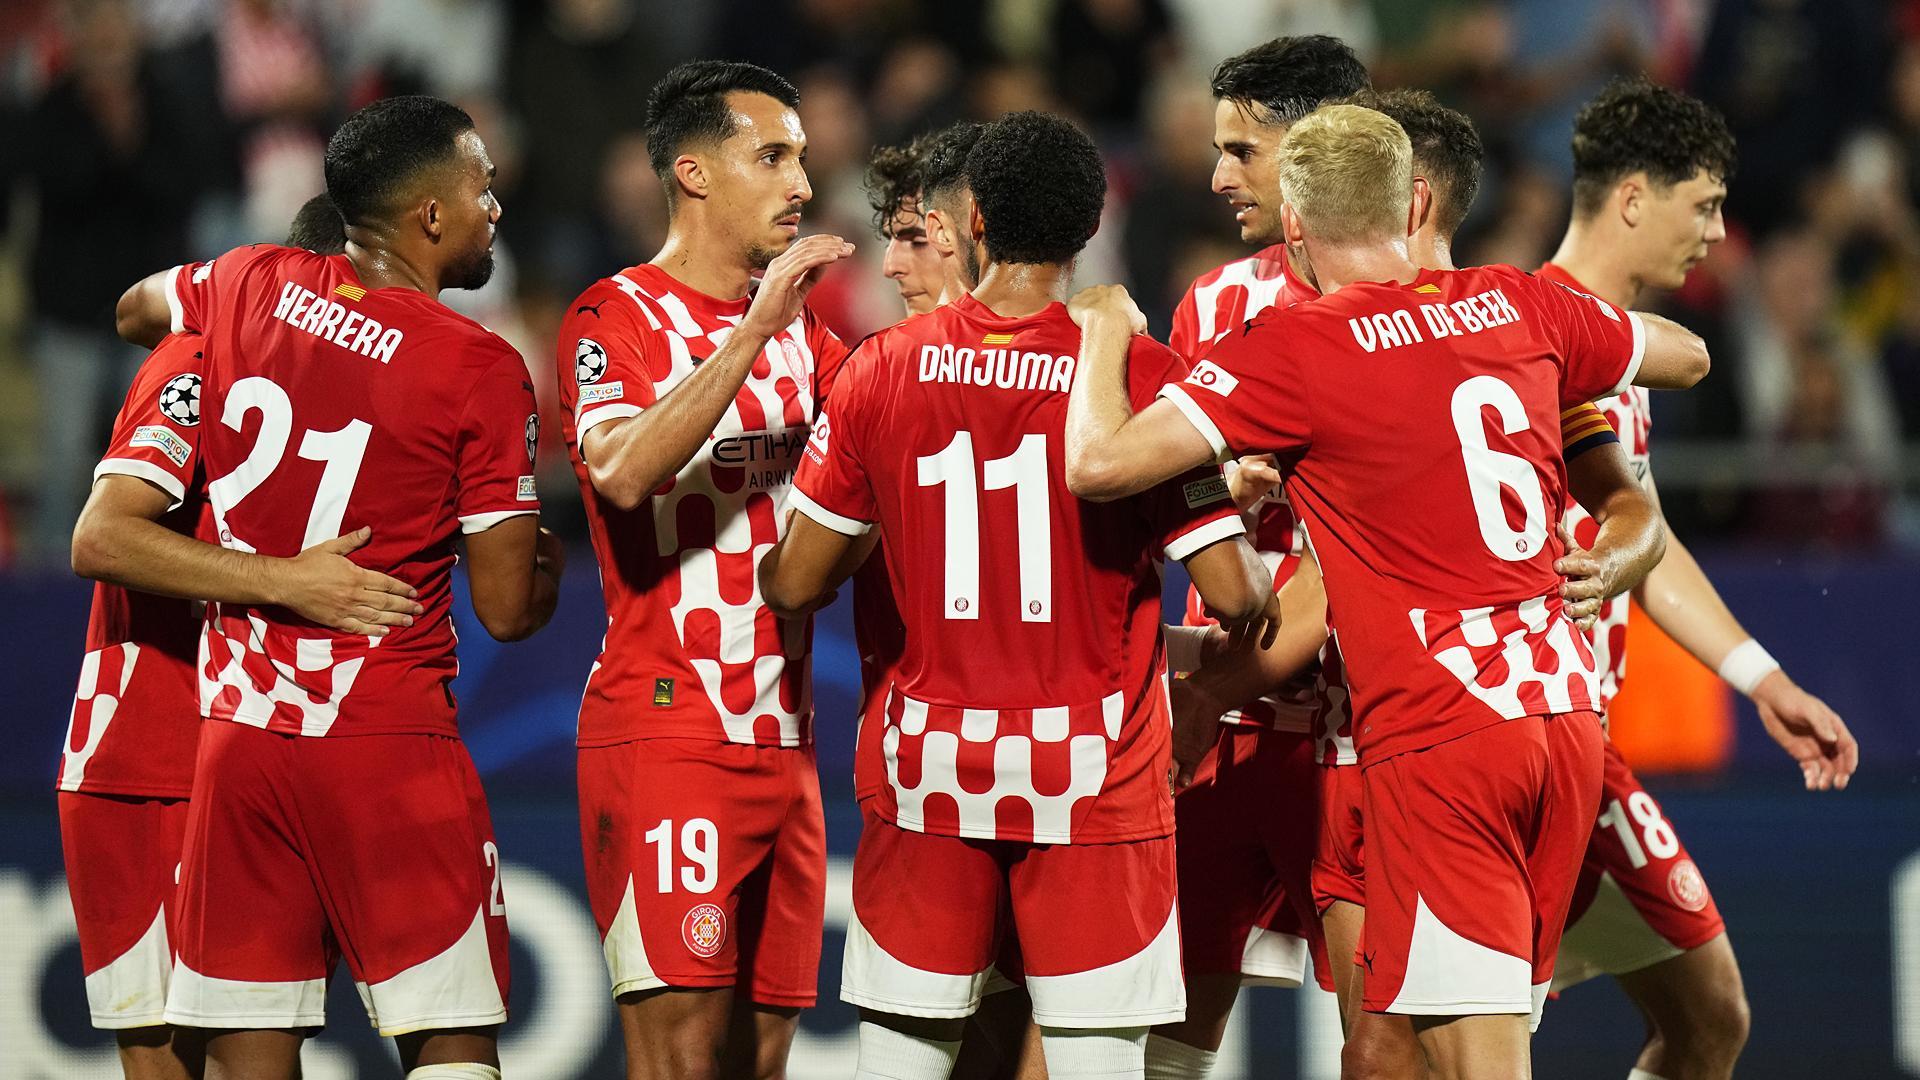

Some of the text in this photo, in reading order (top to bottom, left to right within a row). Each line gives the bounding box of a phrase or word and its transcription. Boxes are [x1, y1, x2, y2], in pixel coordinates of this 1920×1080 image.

[273, 281, 404, 364] HERRERA
[1348, 288, 1521, 353] VAN DE BEEK
[919, 344, 1076, 393] DANJUMA
[208, 377, 373, 553] 21
[1451, 375, 1547, 562] 6
[917, 430, 1051, 623] 11
[645, 818, 719, 893] 19
[1598, 791, 1680, 869] 18
[691, 907, 721, 919] GIRONA
